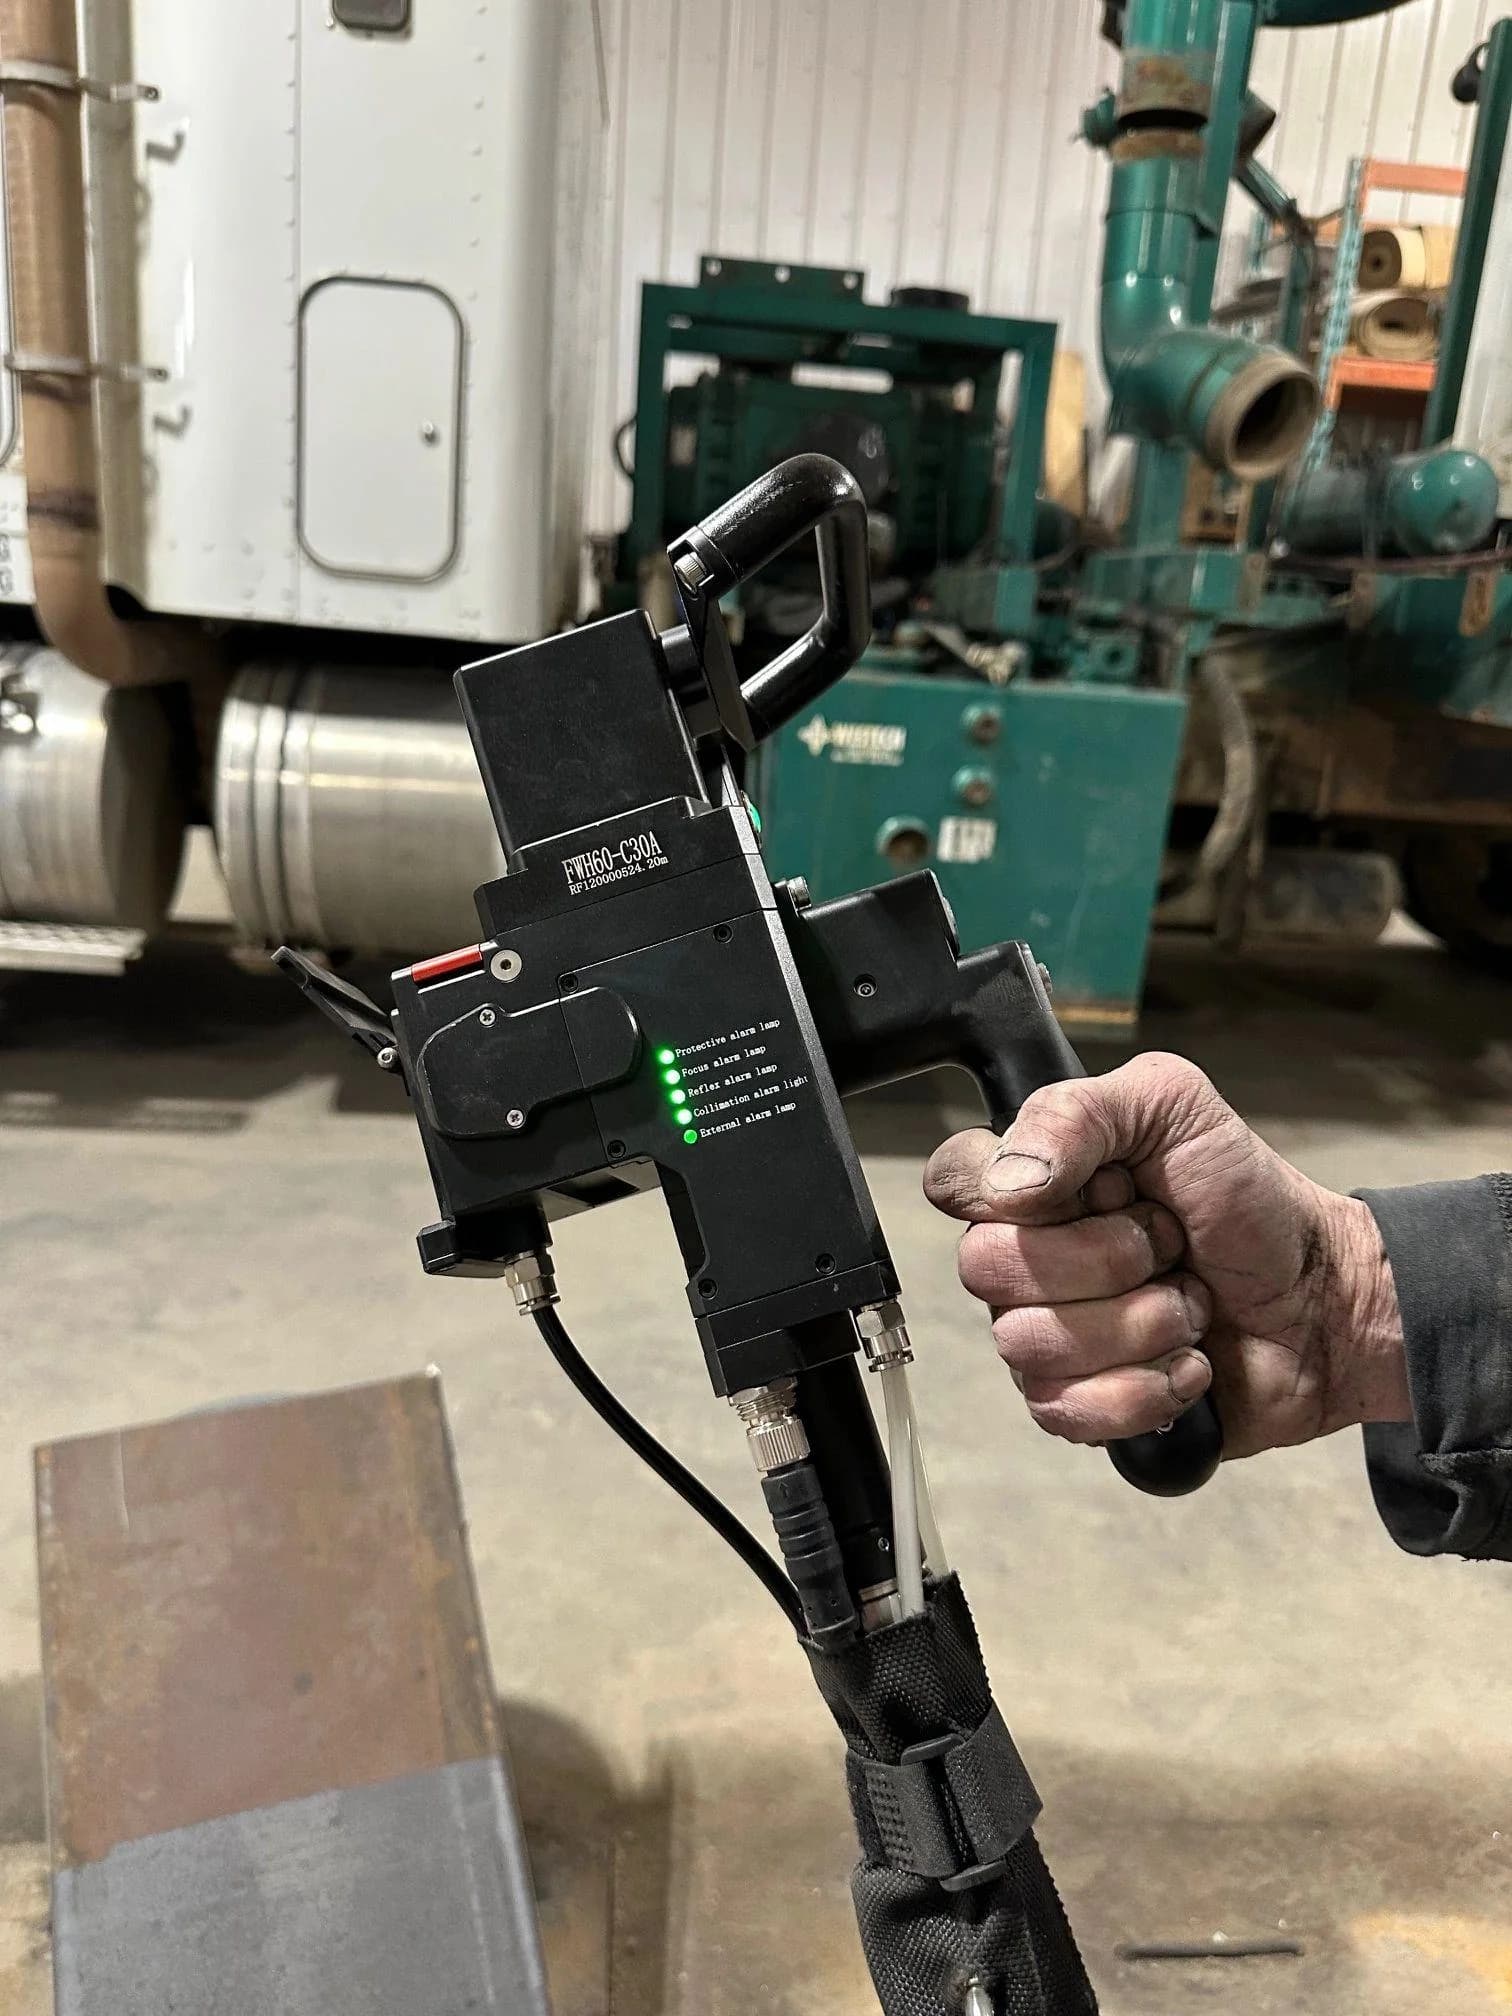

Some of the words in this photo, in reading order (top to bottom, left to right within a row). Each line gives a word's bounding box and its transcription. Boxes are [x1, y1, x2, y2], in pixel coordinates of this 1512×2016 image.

[562, 831, 662, 884] FWH60-C30A
[675, 1036, 726, 1057] Protective
[730, 1027, 756, 1040] alarm
[759, 1019, 780, 1031] lamp
[682, 1063, 709, 1077] Focus
[713, 1053, 740, 1067] alarm
[744, 1046, 766, 1058] lamp
[688, 1082, 720, 1098] Reflex
[725, 1072, 752, 1086] alarm
[755, 1064, 777, 1076] lamp
[694, 1095, 750, 1117] Collimation
[754, 1086, 780, 1098] alarm
[783, 1075, 808, 1089] light
[700, 1117, 741, 1137] External
[745, 1110, 772, 1123] alarm
[775, 1102, 796, 1114] lamp
